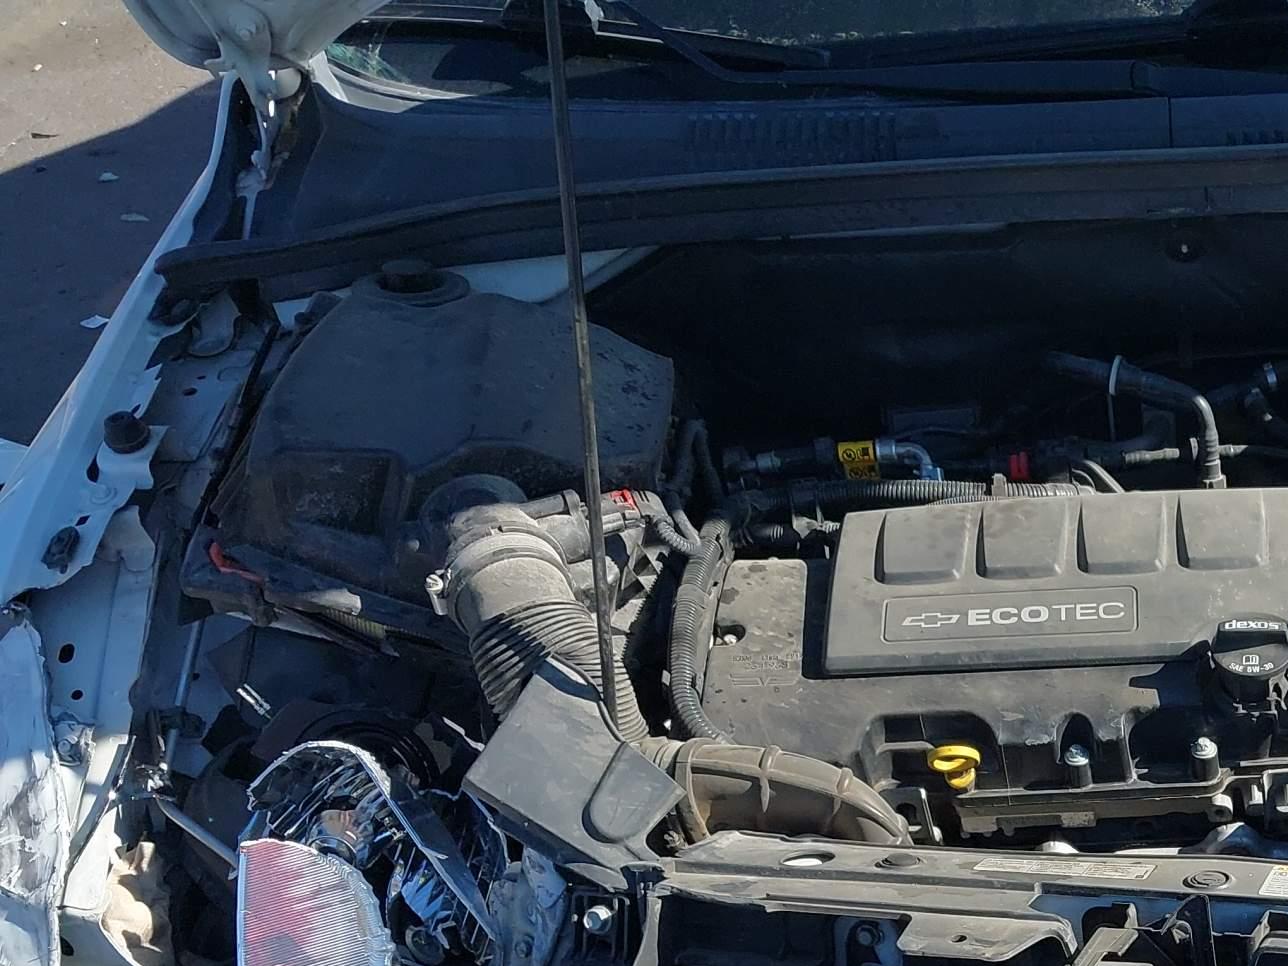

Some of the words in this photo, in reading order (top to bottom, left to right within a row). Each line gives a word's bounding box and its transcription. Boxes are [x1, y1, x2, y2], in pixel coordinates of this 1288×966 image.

[967, 602, 1125, 626] ECOTEC
[1224, 619, 1279, 630] dexos
[1229, 662, 1245, 673] SAE
